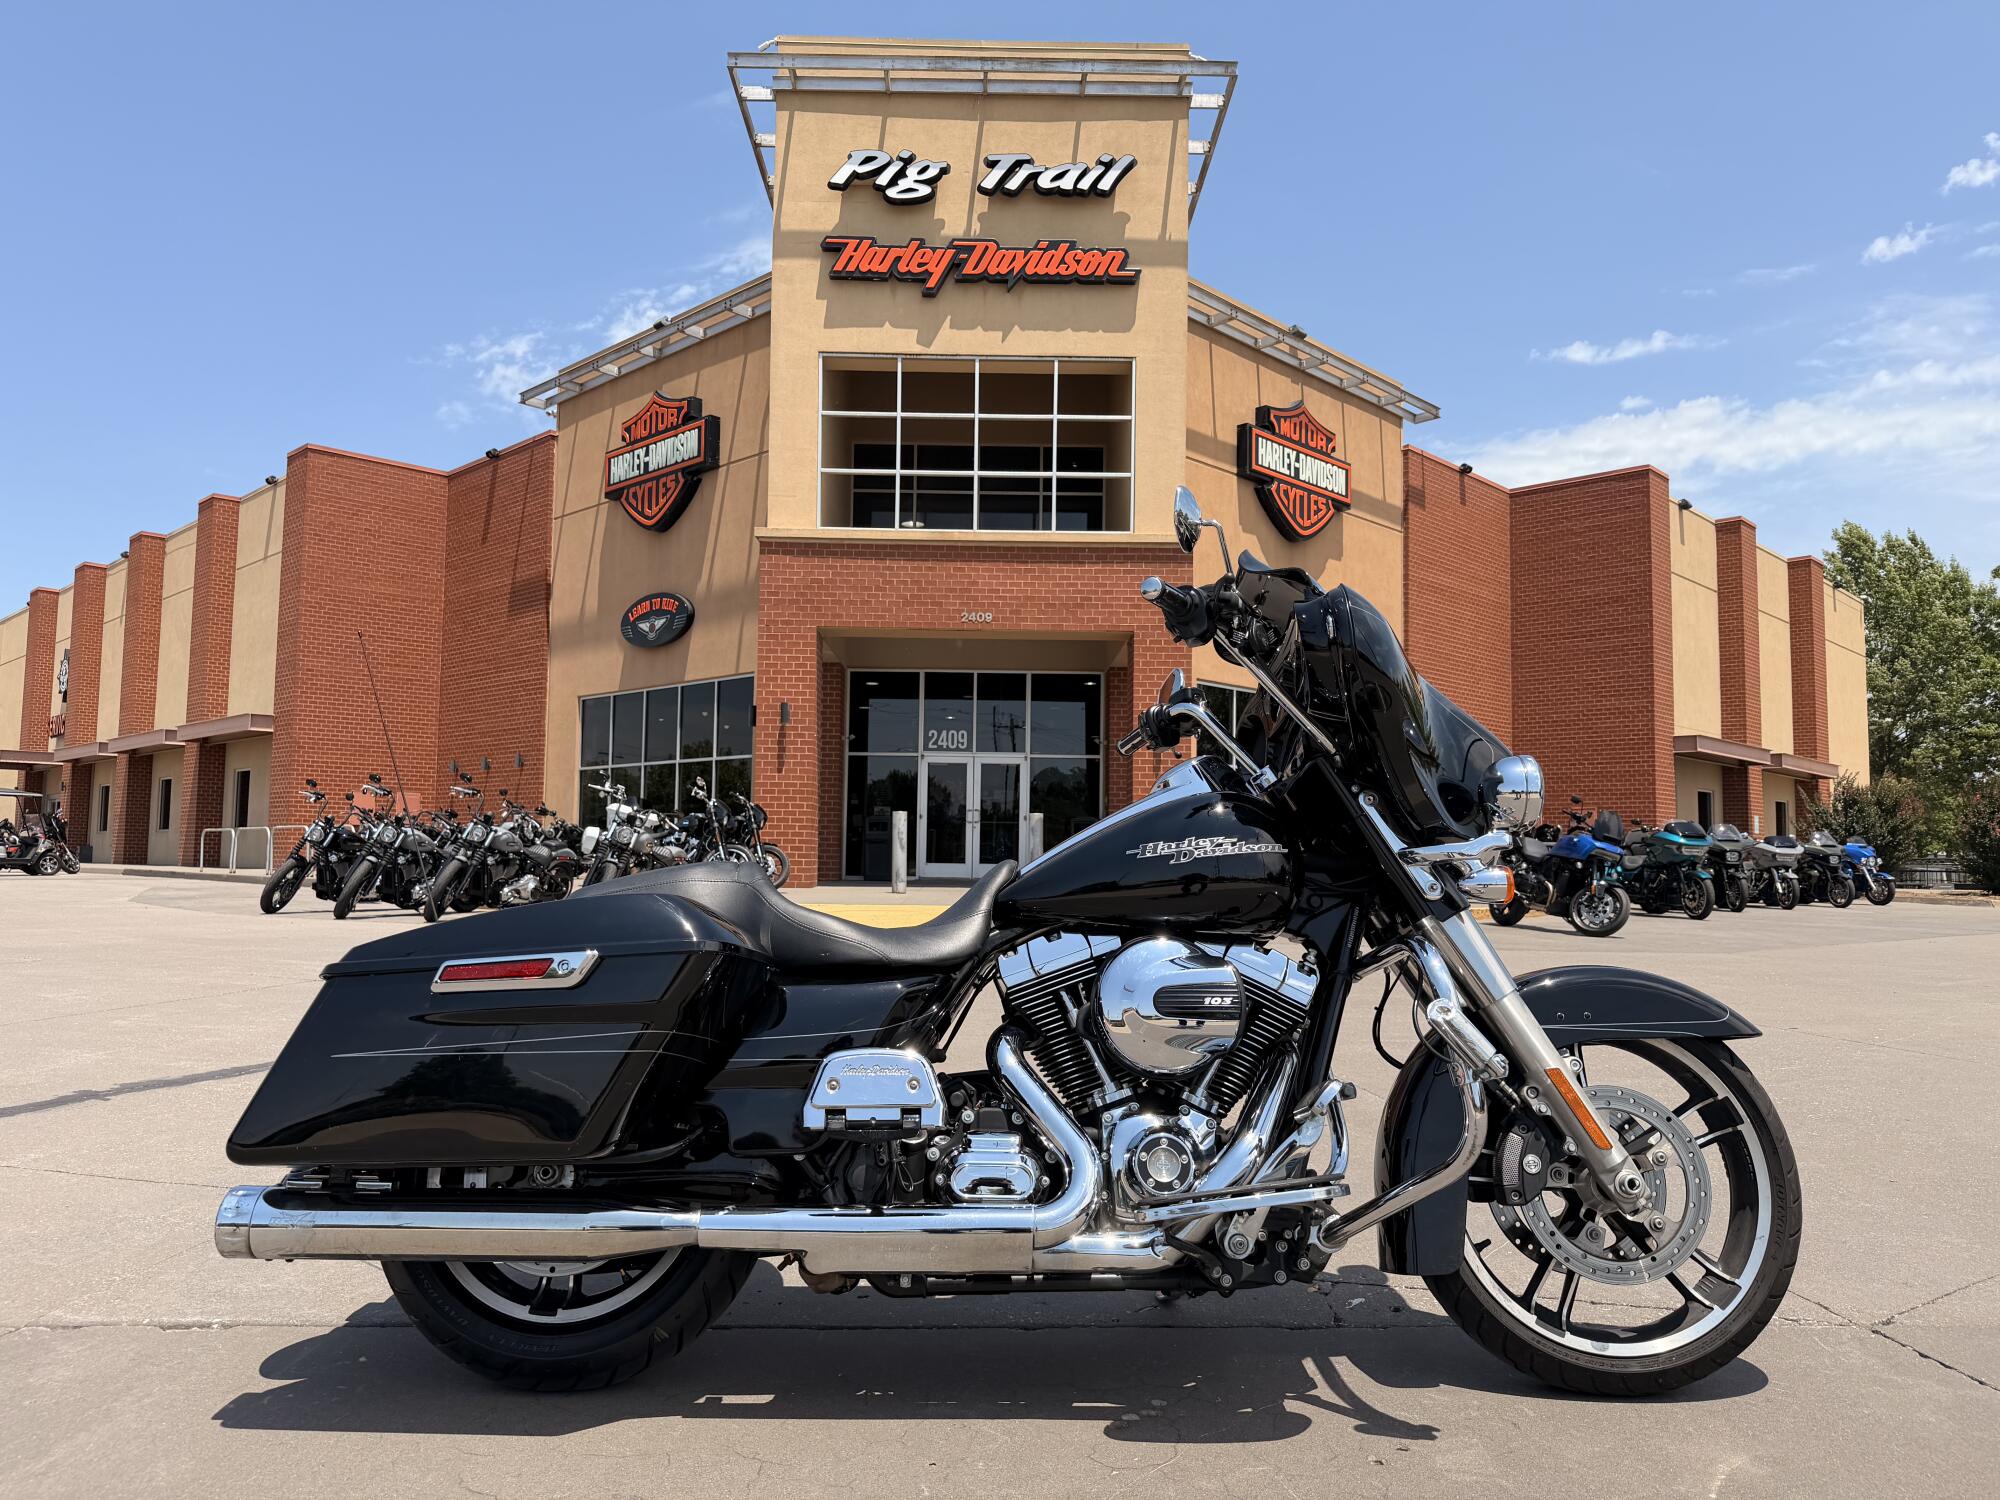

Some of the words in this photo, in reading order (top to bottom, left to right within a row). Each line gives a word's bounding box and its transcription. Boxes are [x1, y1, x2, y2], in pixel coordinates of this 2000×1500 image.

[827, 149, 950, 201] Pig
[978, 153, 1137, 195] Trail
[823, 238, 1138, 291] Harley-Davidson
[630, 404, 678, 441] MOTOR
[1280, 414, 1327, 451] MOTOR
[609, 428, 699, 485] HARLEY-DAVIDSON
[1257, 436, 1346, 497] HARLEY-DAVIDSON
[628, 473, 677, 517] CYCLES
[1279, 483, 1327, 528] CYCLES
[628, 600, 651, 623] LEARN
[652, 598, 661, 610] TO
[661, 598, 679, 613] RIDE
[960, 612, 993, 623] 2409
[928, 729, 968, 749] 2409
[1203, 996, 1233, 1005] 103
